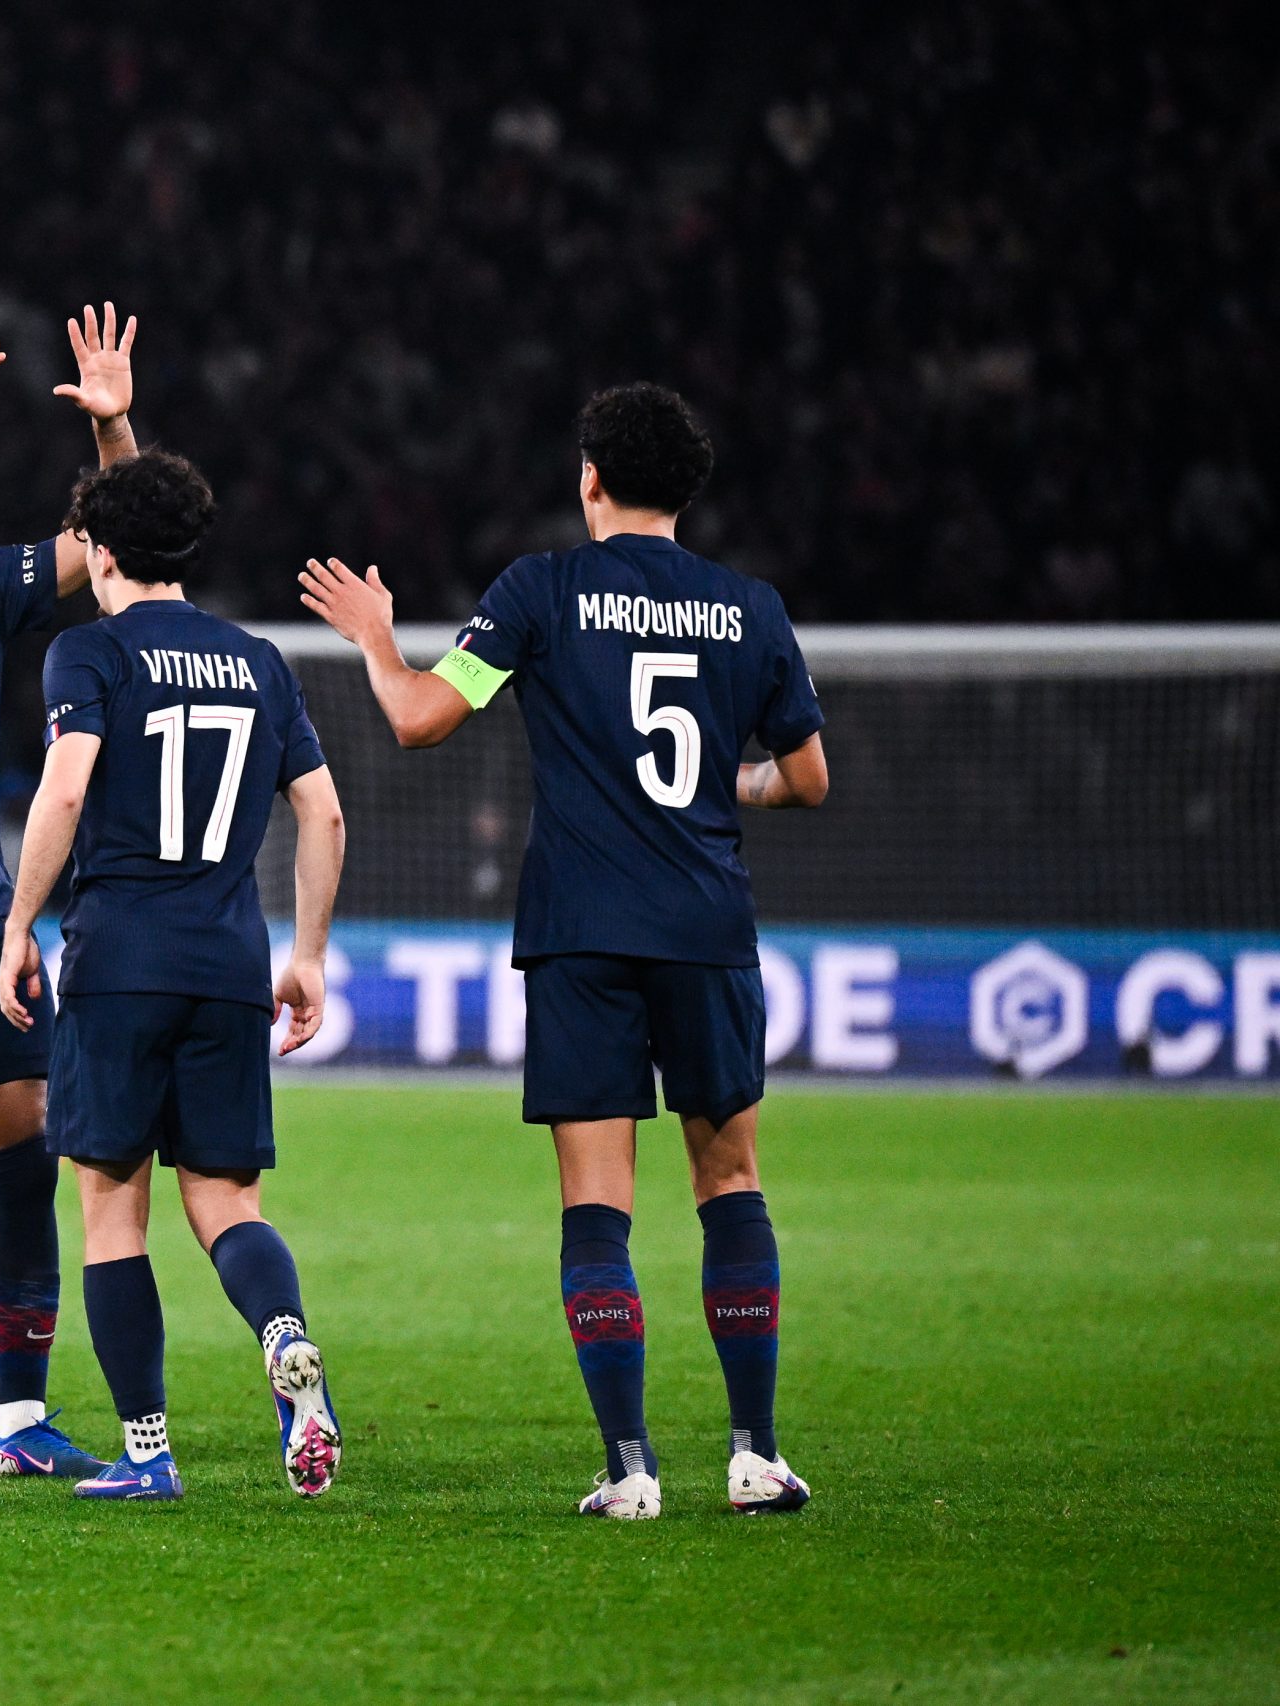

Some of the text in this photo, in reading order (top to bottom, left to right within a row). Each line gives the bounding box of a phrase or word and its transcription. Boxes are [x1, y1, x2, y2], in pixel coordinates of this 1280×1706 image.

[578, 592, 742, 643] MARQUINHOS
[139, 649, 258, 692] VITINHA
[630, 651, 701, 809] 5
[144, 704, 256, 863] 17
[576, 1308, 631, 1325] PARIS
[716, 1305, 771, 1319] PARIS
